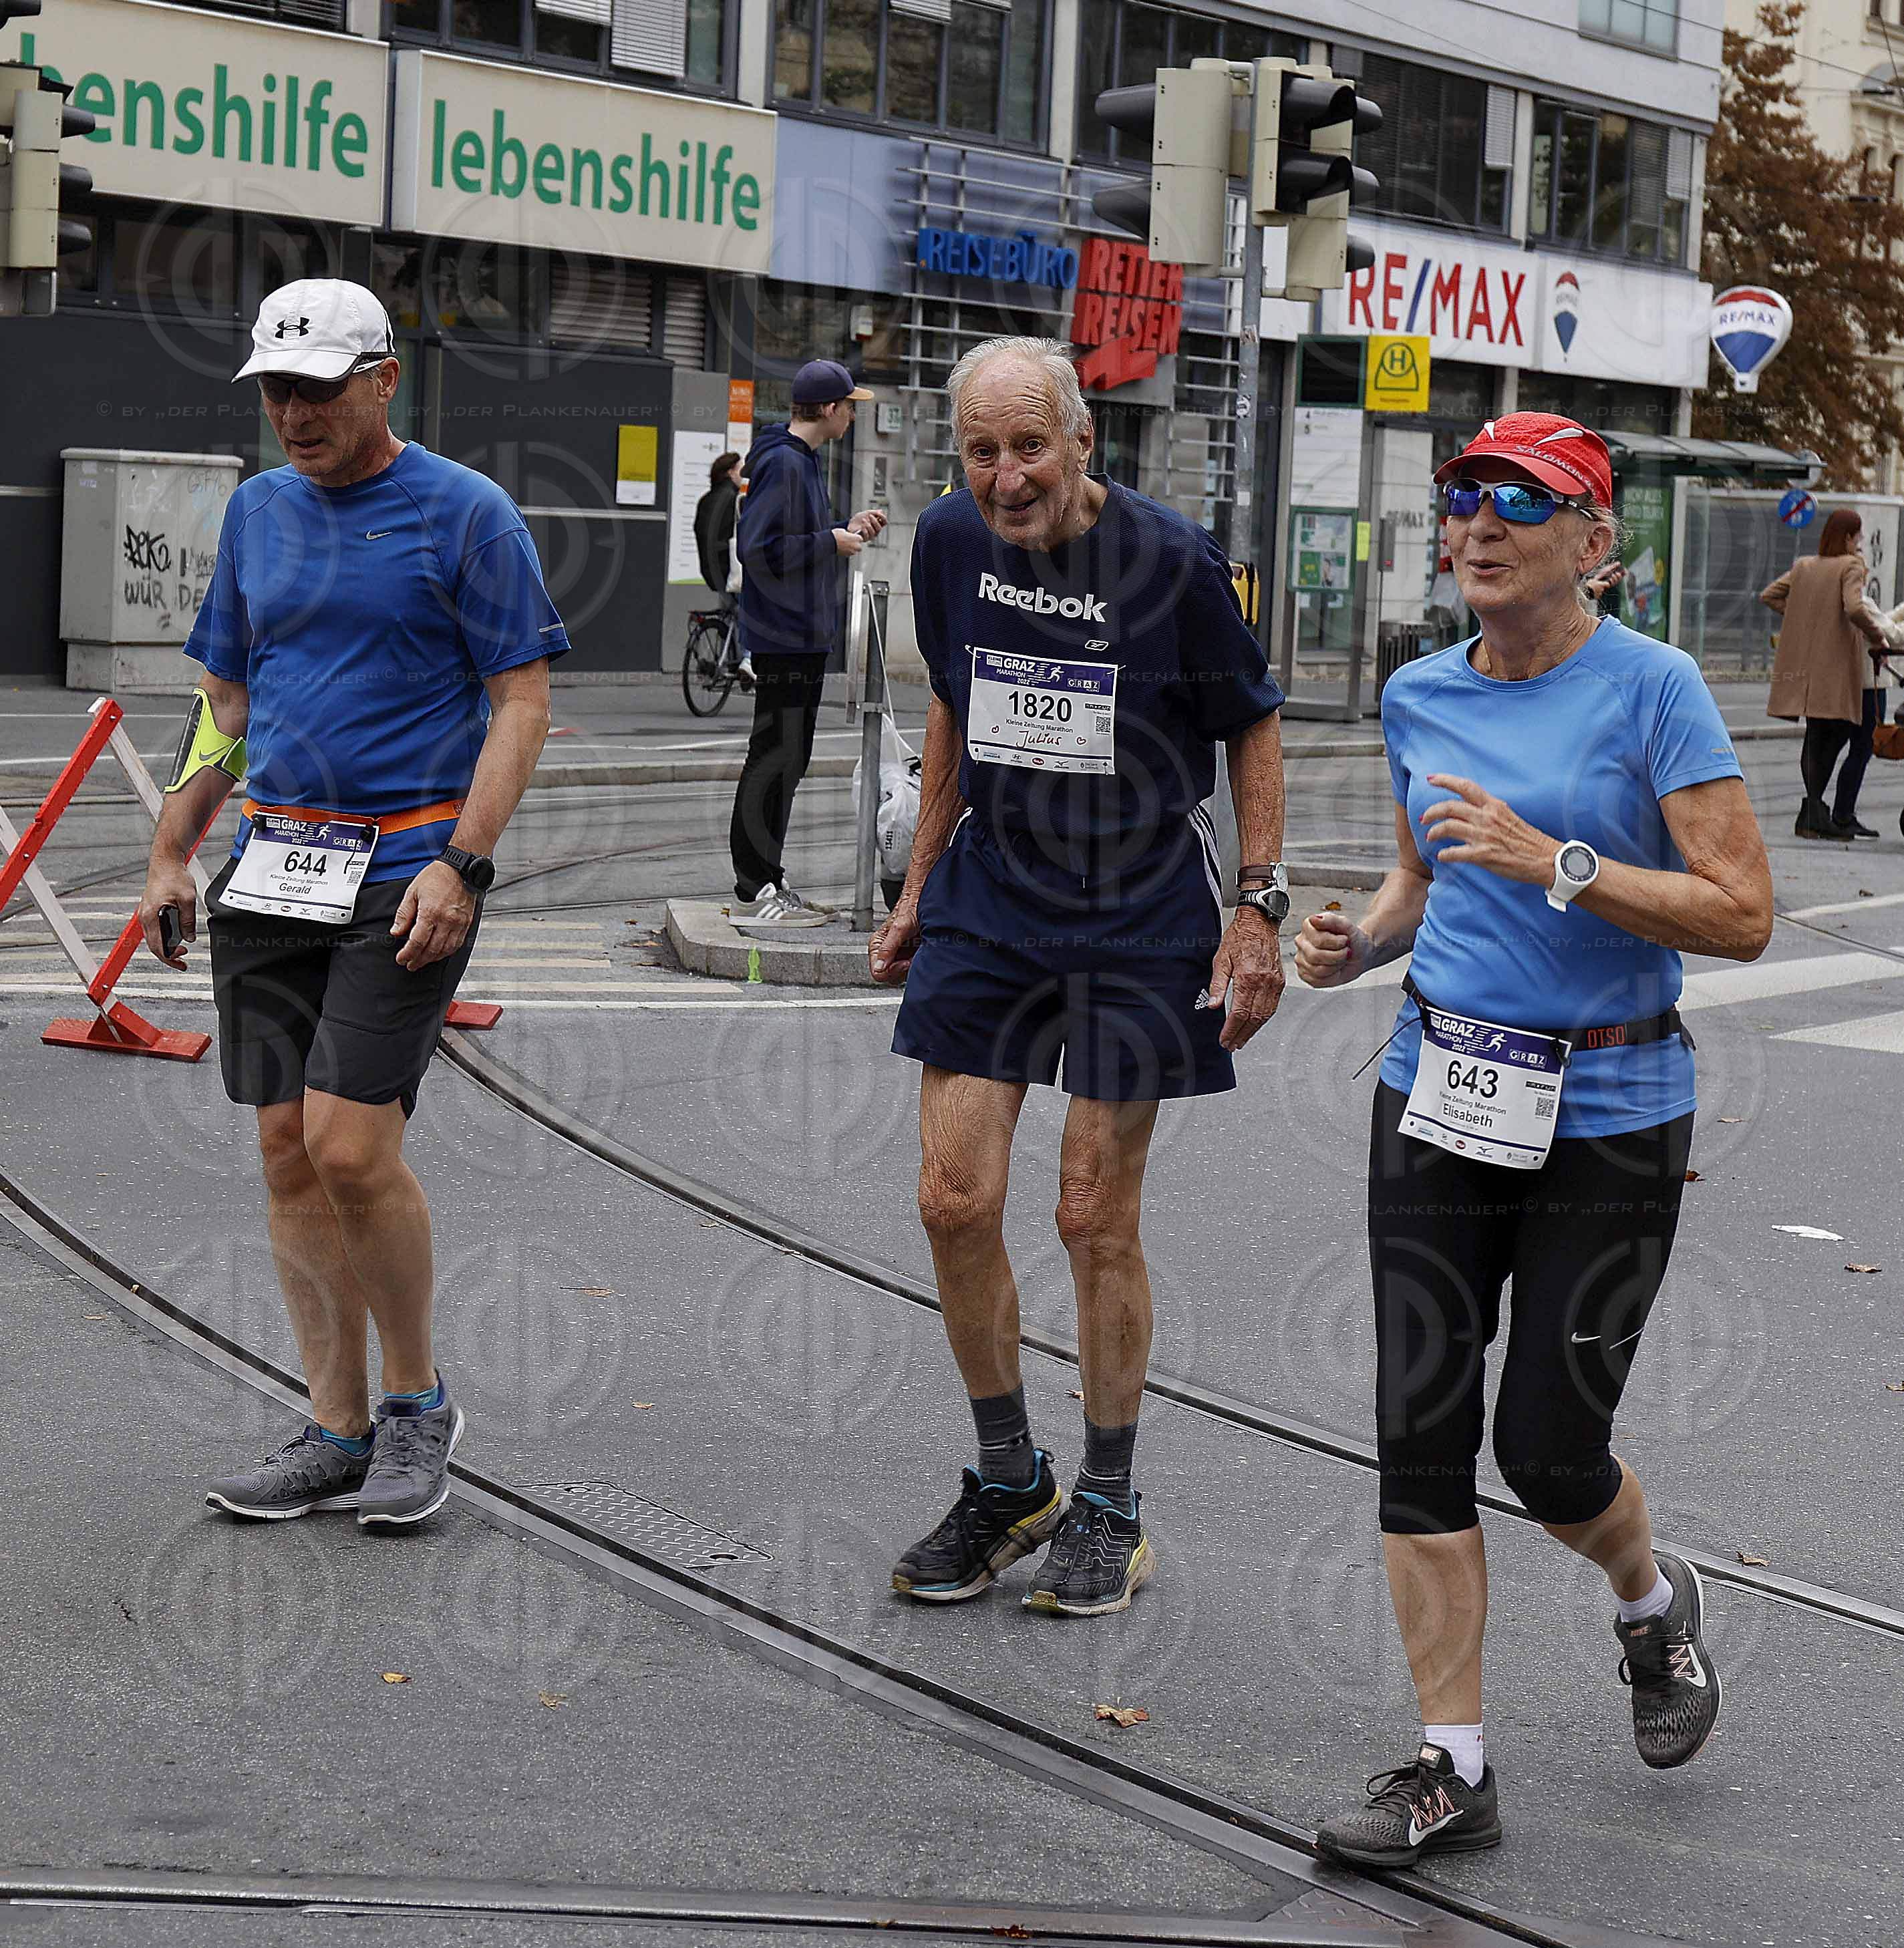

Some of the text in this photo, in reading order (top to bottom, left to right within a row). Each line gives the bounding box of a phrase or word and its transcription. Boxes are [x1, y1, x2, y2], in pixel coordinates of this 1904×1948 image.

[431, 99, 760, 230] lebenshilfe
[919, 227, 1078, 289] REISEBÜRO
[1349, 253, 1526, 346] RE/MAX
[1070, 293, 1182, 354] REISEN
[1720, 312, 1776, 327] RE/MAX
[978, 572, 1108, 623] Reebok
[996, 668, 1025, 678] MARATHON
[1003, 657, 1036, 672] GRAZ
[1008, 691, 1073, 722] 1820
[1005, 718, 1073, 734] Kleine Zeitung Marathon
[281, 819, 307, 831] GRAZ
[285, 850, 327, 876] 644
[279, 882, 311, 895] Gerald
[1442, 1018, 1476, 1037] GRAZ
[1587, 1025, 1625, 1048] OTSO
[1447, 1060, 1498, 1098] 643
[1443, 1103, 1493, 1128] Elisabeth
[1474, 1102, 1506, 1115] Marathon
